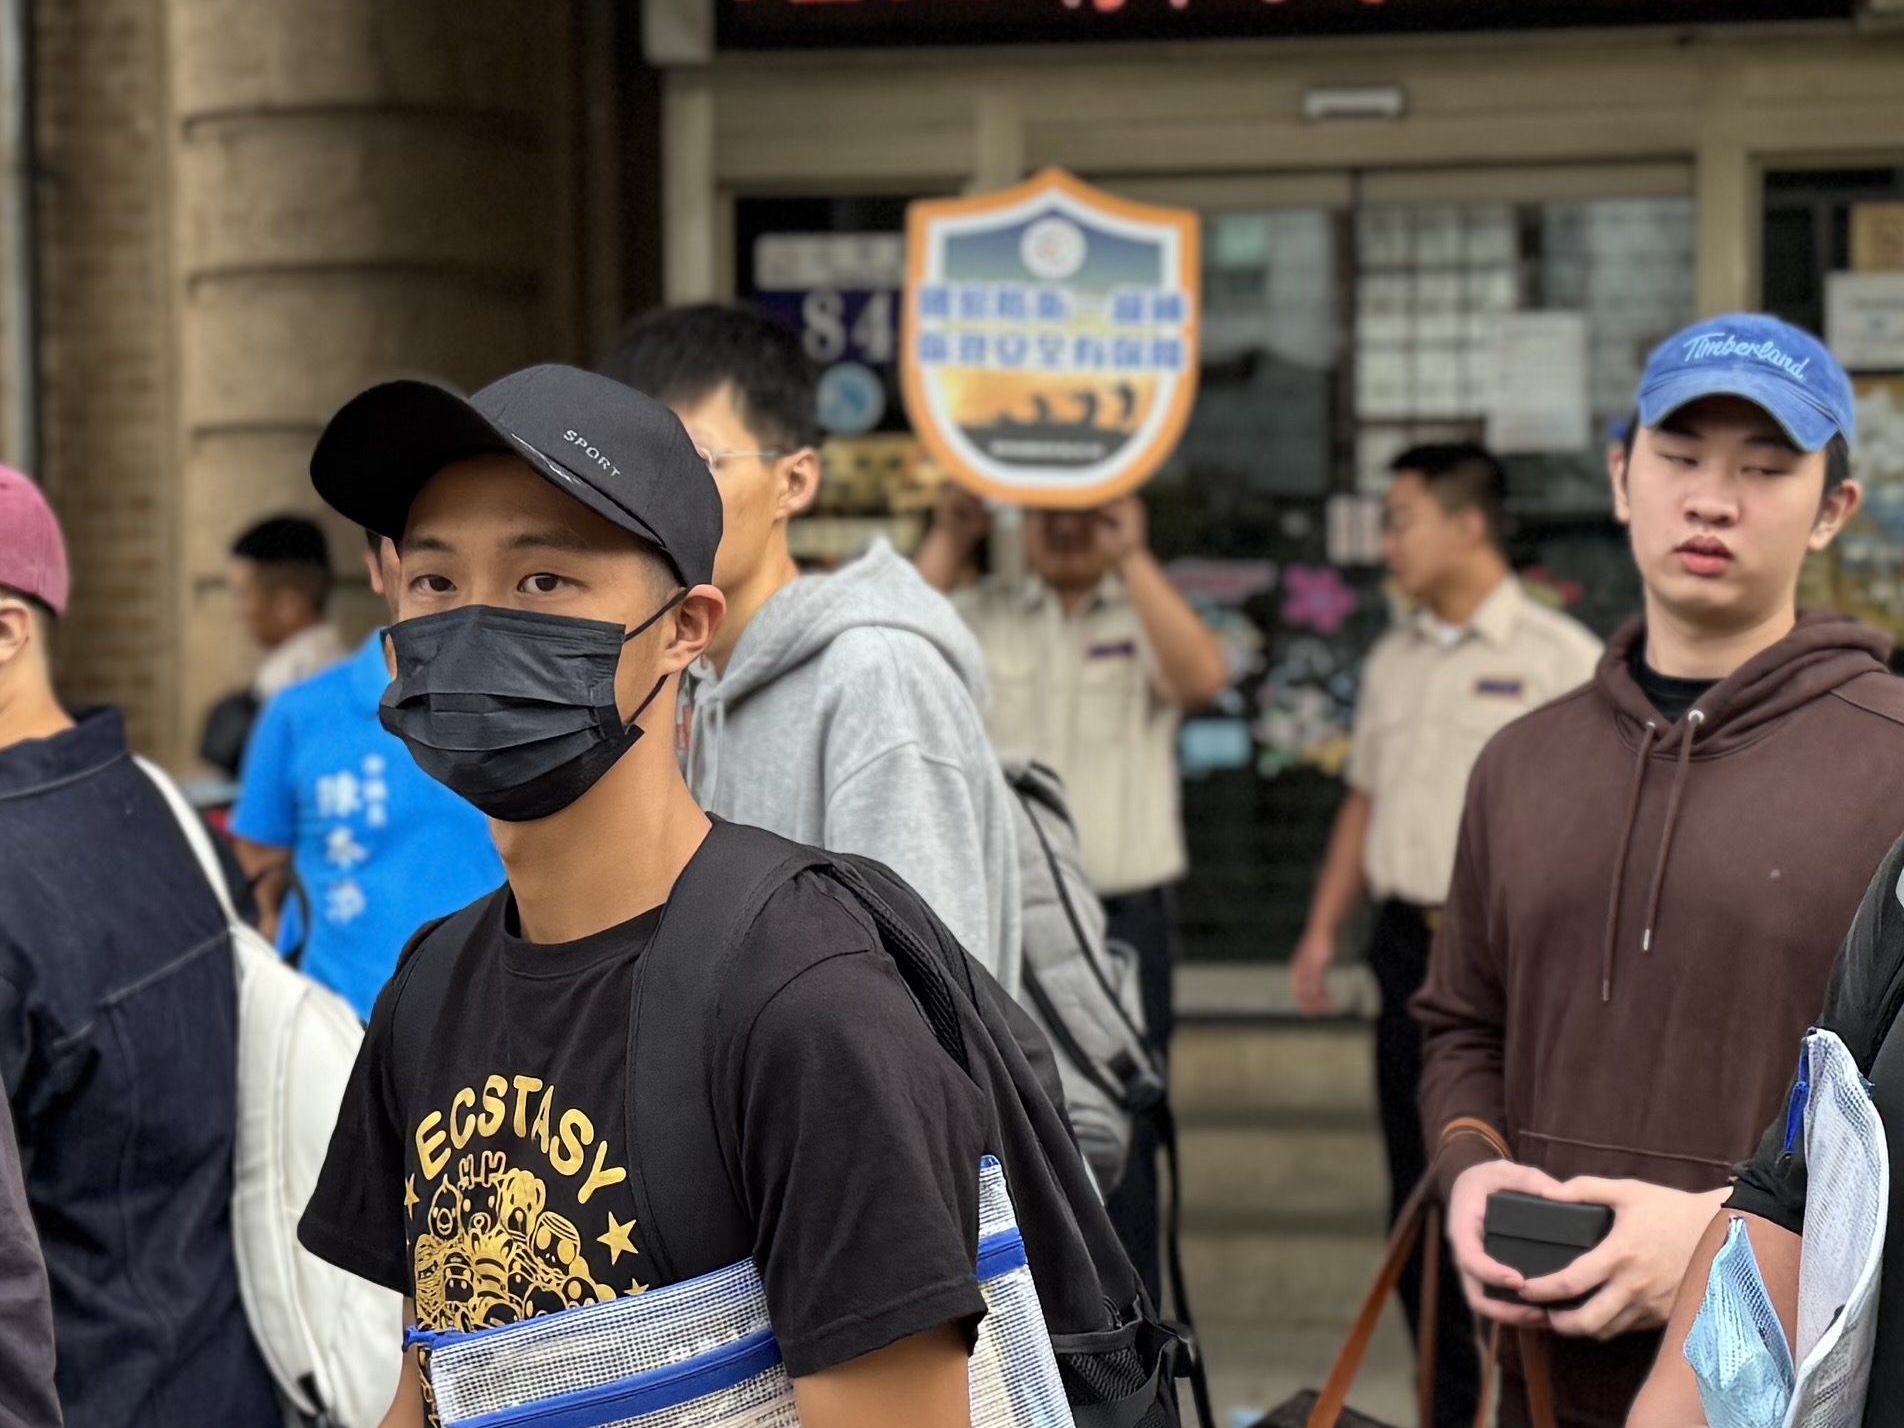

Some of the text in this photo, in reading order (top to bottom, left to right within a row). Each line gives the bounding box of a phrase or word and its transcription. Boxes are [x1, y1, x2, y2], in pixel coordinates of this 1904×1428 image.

[801, 288, 893, 363] 84
[1682, 332, 1811, 379] Timberland
[562, 429, 621, 477] SPORT
[414, 1074, 627, 1204] ECSTASY
